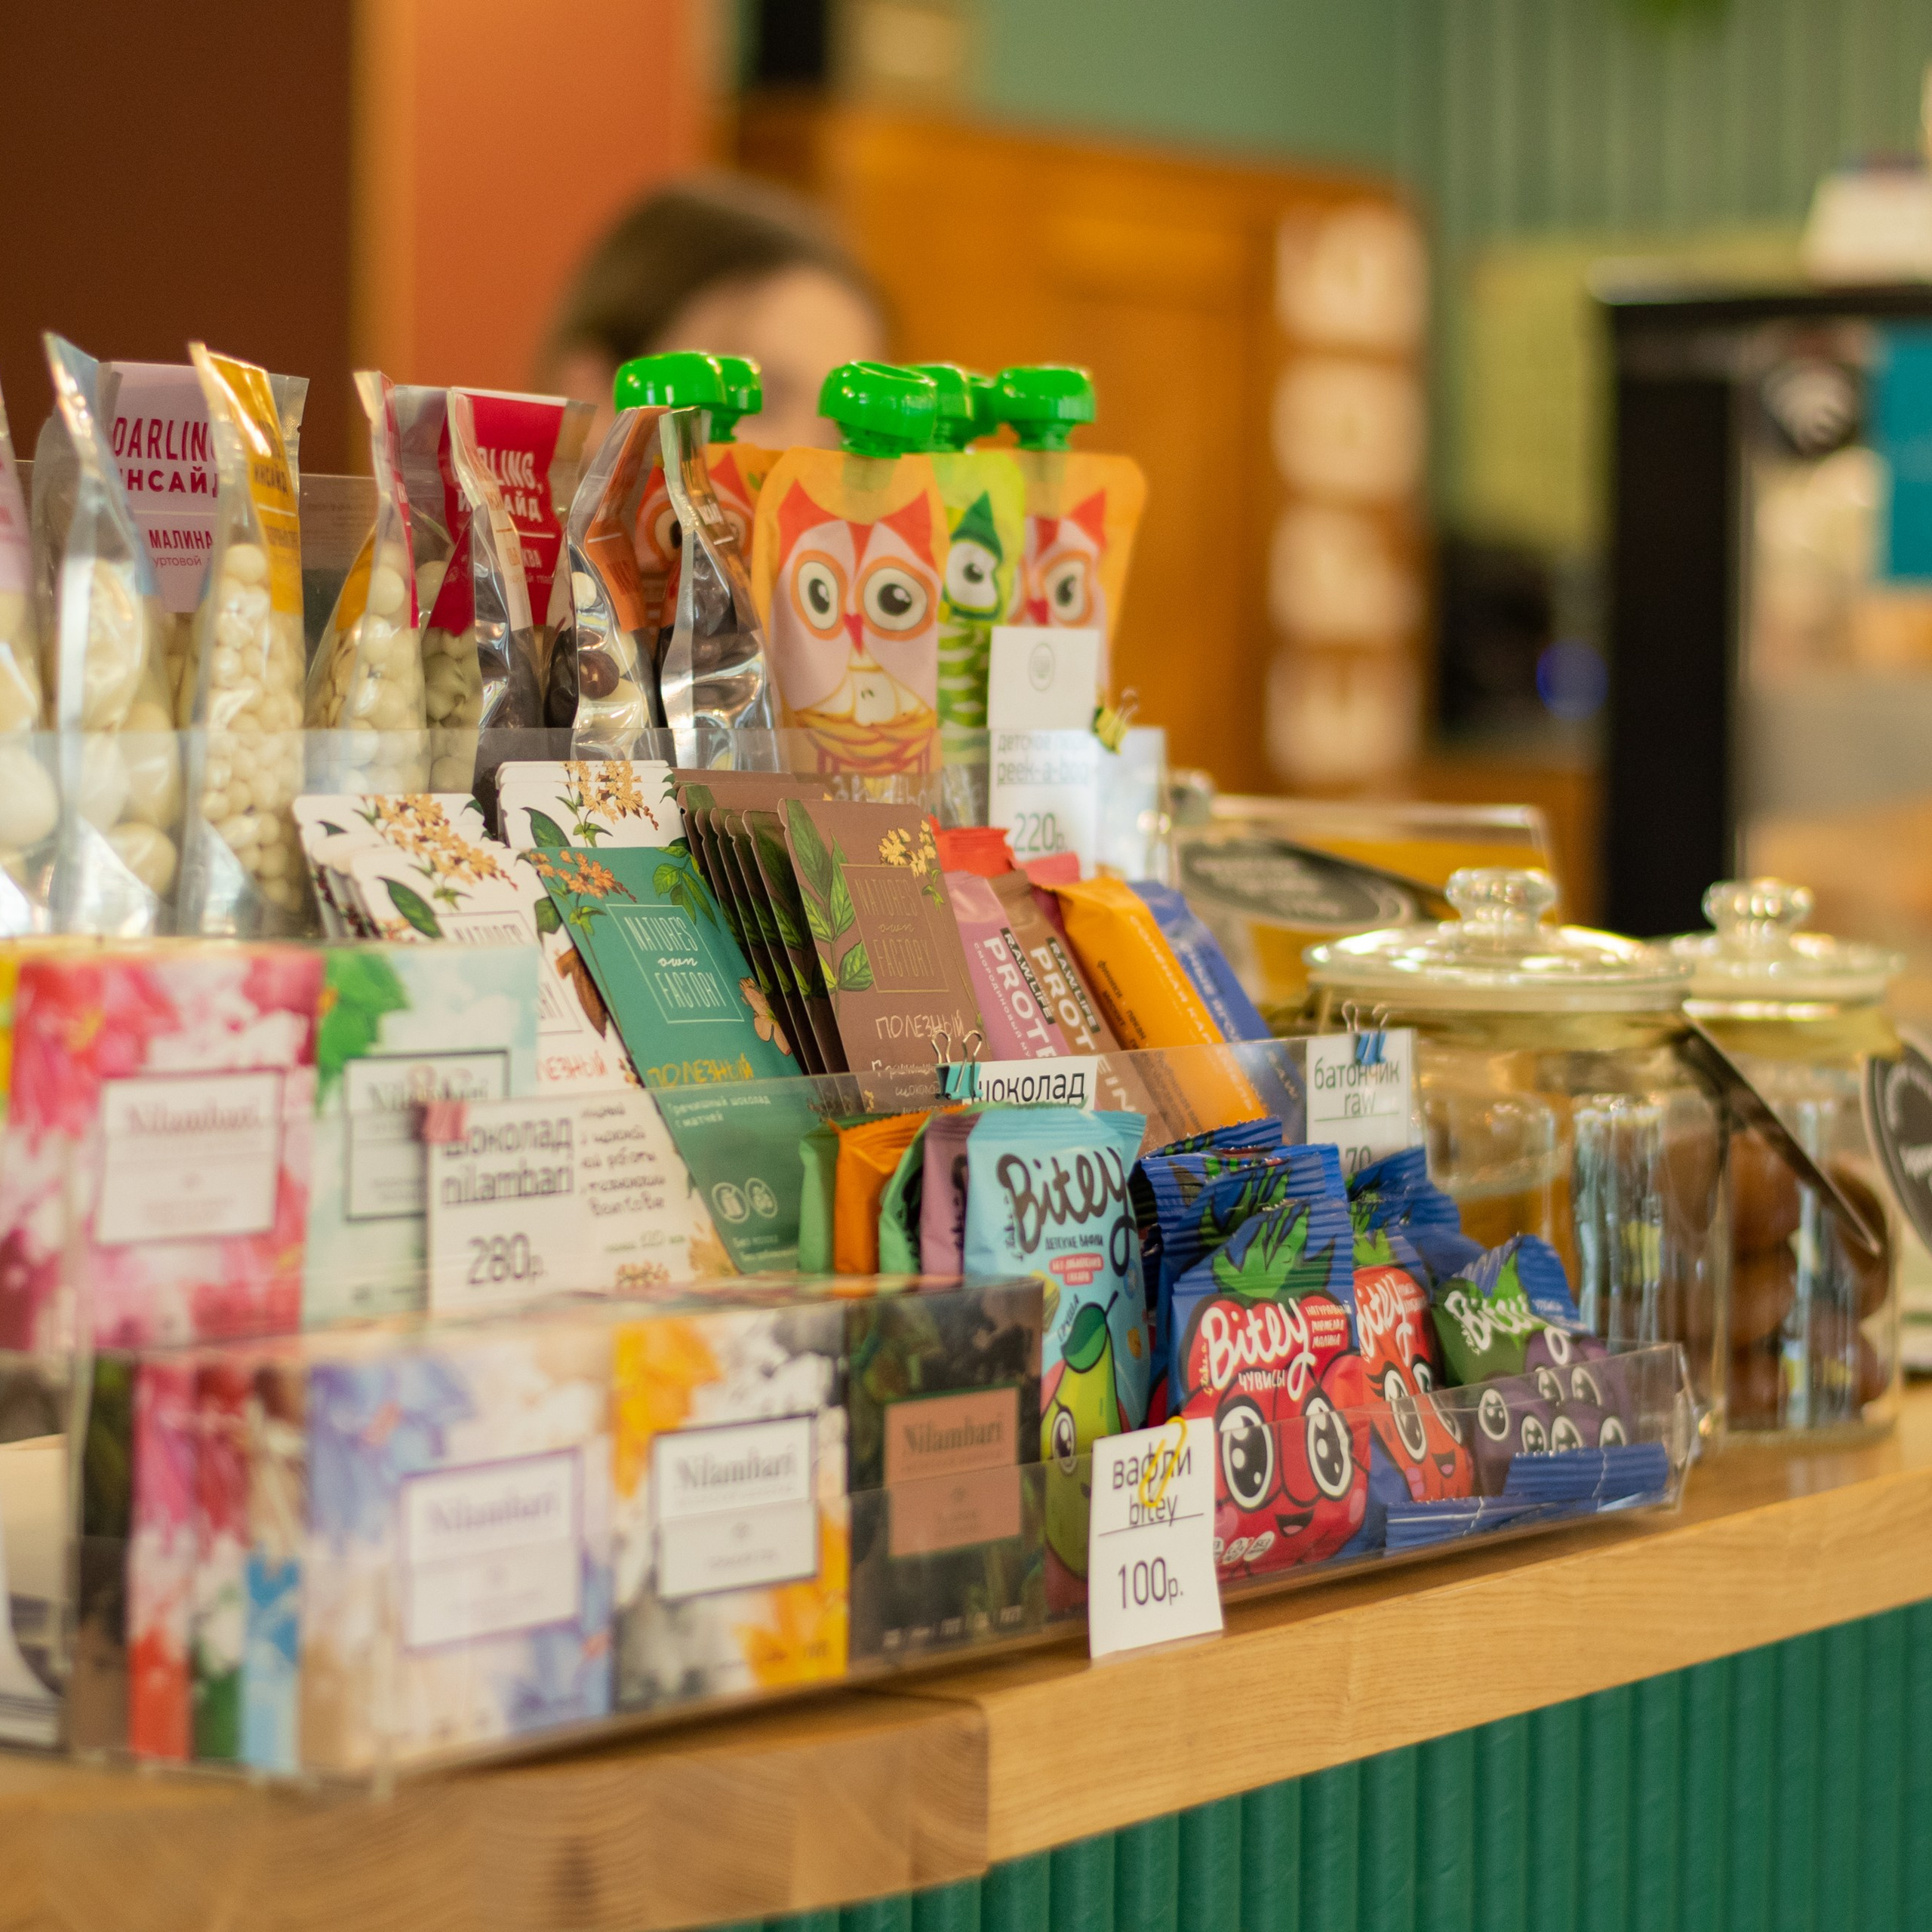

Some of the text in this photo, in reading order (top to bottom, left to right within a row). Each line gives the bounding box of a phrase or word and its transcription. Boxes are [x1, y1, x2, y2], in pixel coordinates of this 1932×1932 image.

[113, 417, 217, 463] DARLIN
[119, 466, 218, 499] НСАЙ
[149, 529, 213, 549] МАЛИНА
[153, 555, 202, 568] уртовой
[878, 923, 915, 933] own
[657, 957, 698, 968] own
[872, 938, 934, 977] FACTORY
[654, 972, 727, 1008] FACTORY
[974, 943, 1023, 1038] СМОРОДИНОВЫЙ
[983, 937, 1057, 1057] PROTE
[1097, 959, 1123, 998] финики
[1127, 1009, 1147, 1041] пекан
[875, 1009, 965, 1040] ПОЛЕЗНЫЙ
[537, 1049, 608, 1082] ЛЕЗНЫЙ
[647, 1052, 754, 1088] ПОЛЕЗНЫЙ
[1314, 1057, 1400, 1091] батончик
[1344, 1092, 1377, 1117] raw
[995, 1146, 1137, 1277] Bitey
[1201, 1297, 1317, 1402] Bitey
[1112, 1442, 1192, 1494] вафли
[1128, 1494, 1179, 1527] bitey
